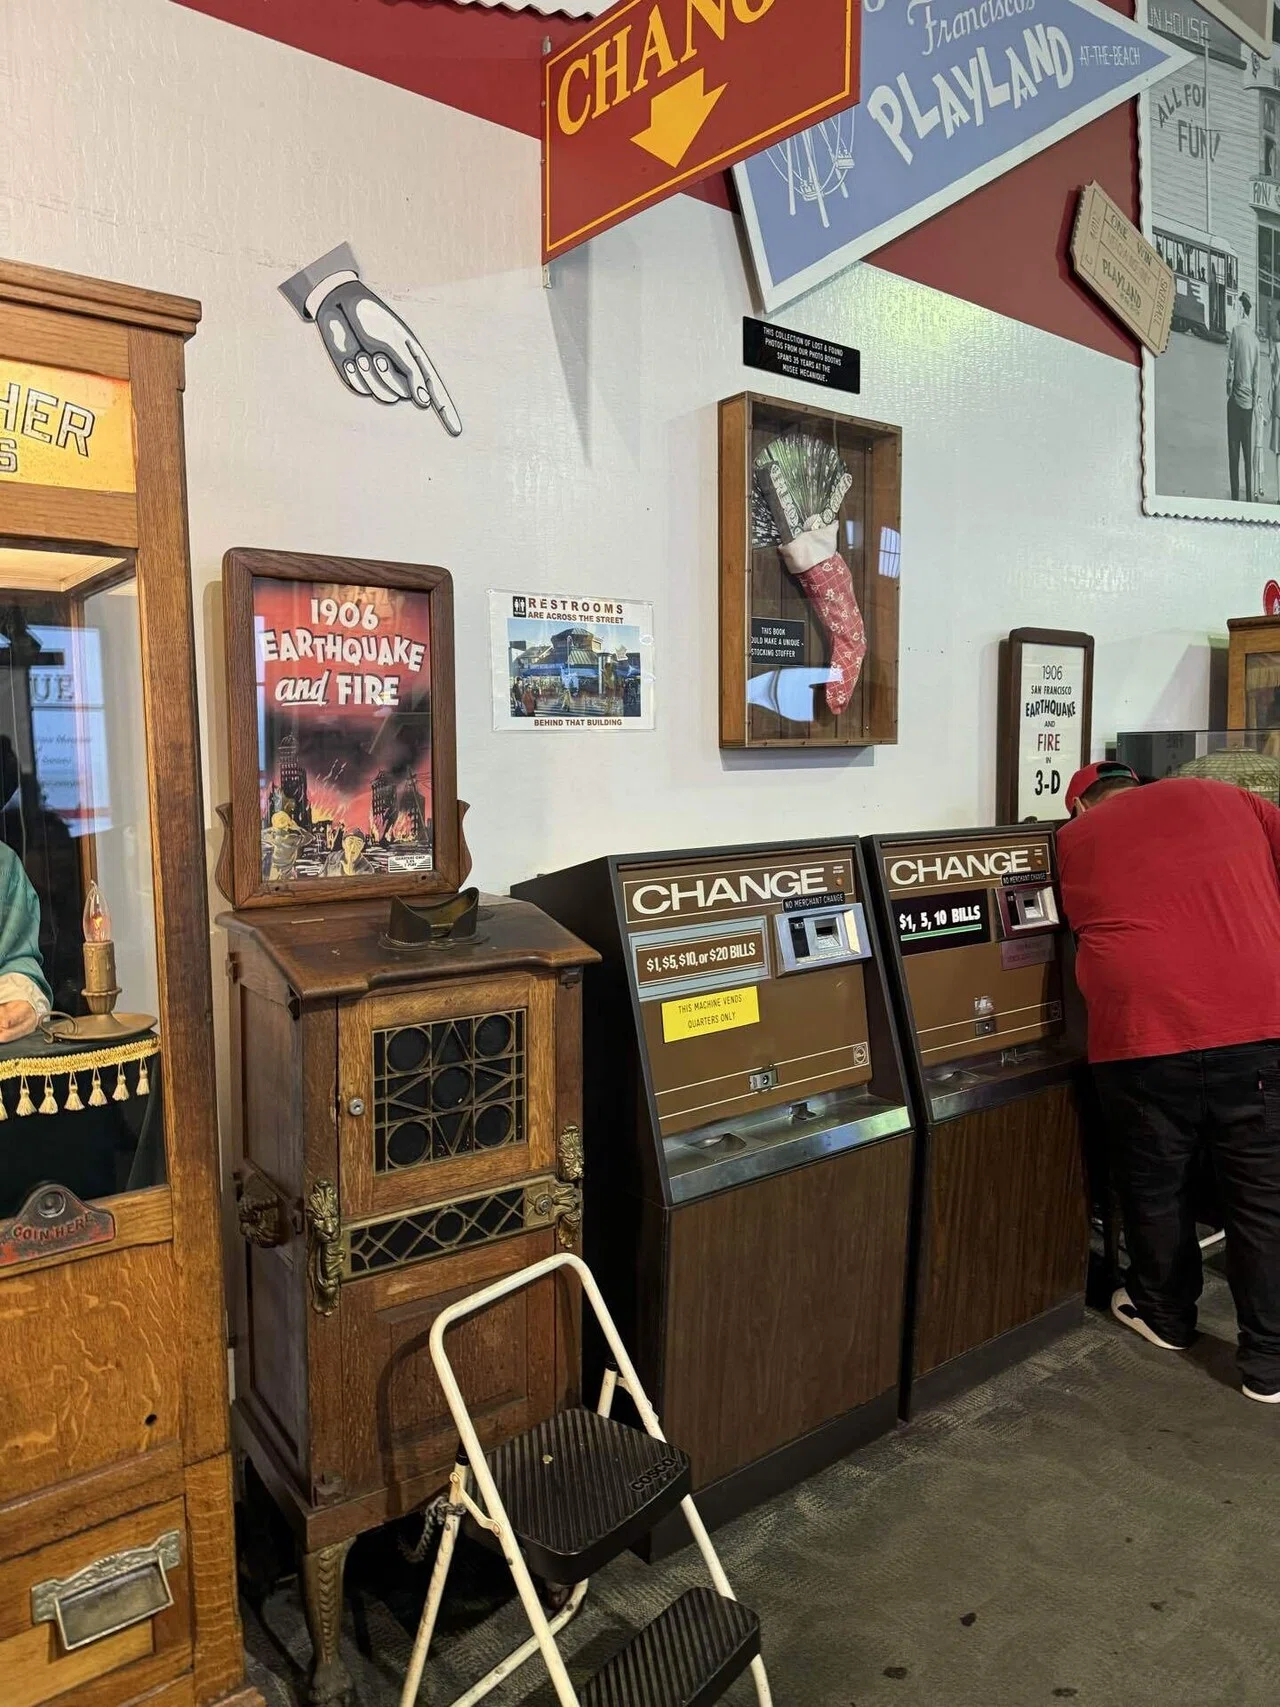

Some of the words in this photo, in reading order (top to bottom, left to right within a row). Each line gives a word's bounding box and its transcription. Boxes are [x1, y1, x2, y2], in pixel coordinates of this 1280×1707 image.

[1080, 45, 1140, 67] AT-THE-BEACH
[867, 24, 1074, 166] PLAYLAND
[1157, 87, 1182, 128] ALL
[1102, 259, 1142, 310] PLAYLAND
[763, 327, 774, 337] THIS
[775, 329, 803, 345] COLLECTION
[803, 339, 811, 347] OF
[812, 340, 823, 350] LOST
[828, 346, 844, 357] FOUND
[765, 338, 783, 350] PHOTOS
[784, 343, 798, 354] FROM
[798, 347, 808, 356] OUR
[809, 350, 824, 361] PHOTO
[825, 355, 842, 367] BOOTHS
[777, 352, 792, 363] SPANS
[800, 359, 815, 370] YEARS
[822, 364, 831, 374] THE
[782, 364, 799, 375] MUSEE
[800, 369, 828, 382] MECANIQUE.
[311, 598, 379, 630] 1906
[528, 597, 623, 614] RESTROOMS
[546, 612, 577, 621] ACROSS
[596, 616, 624, 624] STREET
[761, 627, 772, 635] THIS
[772, 628, 785, 636] BOOK
[262, 628, 426, 672] EARTHQUAKE
[764, 637, 777, 645] MAKE
[783, 639, 800, 647] UNIQUE
[751, 648, 774, 657] STOCKING
[775, 650, 796, 658] STUFFER
[1042, 665, 1063, 680] 1906
[275, 670, 331, 705] and
[336, 673, 400, 706] FIRE
[1031, 685, 1041, 695] SAN
[1044, 685, 1072, 695] FRANCISCO
[1025, 699, 1076, 718] EARTHQUAKE
[534, 719, 563, 727] BEHIND
[566, 719, 585, 727] THAT
[587, 719, 622, 727] BUILDING
[1044, 720, 1055, 728] AND
[1037, 734, 1061, 752] FIRE
[1034, 769, 1061, 796] 3-D
[890, 850, 1031, 886] CHANGE
[632, 867, 828, 915] CHANGE
[785, 901, 793, 909] NO
[794, 896, 822, 907] MERCHANT
[823, 894, 843, 903] CHANGE
[899, 912, 917, 932] $1,
[921, 911, 932, 930] 5,
[934, 909, 947, 926] 10
[951, 905, 981, 923] BILLS
[709, 946, 728, 963] $20
[729, 942, 756, 959] BILLS
[678, 1003, 692, 1014] THIS
[694, 998, 721, 1011] MACHINE
[722, 994, 742, 1005] VENDS
[687, 1015, 719, 1028] QUARTERS
[720, 1011, 736, 1022] ONLY
[12, 1223, 49, 1240] COIN
[630, 1457, 677, 1491] COSCO
